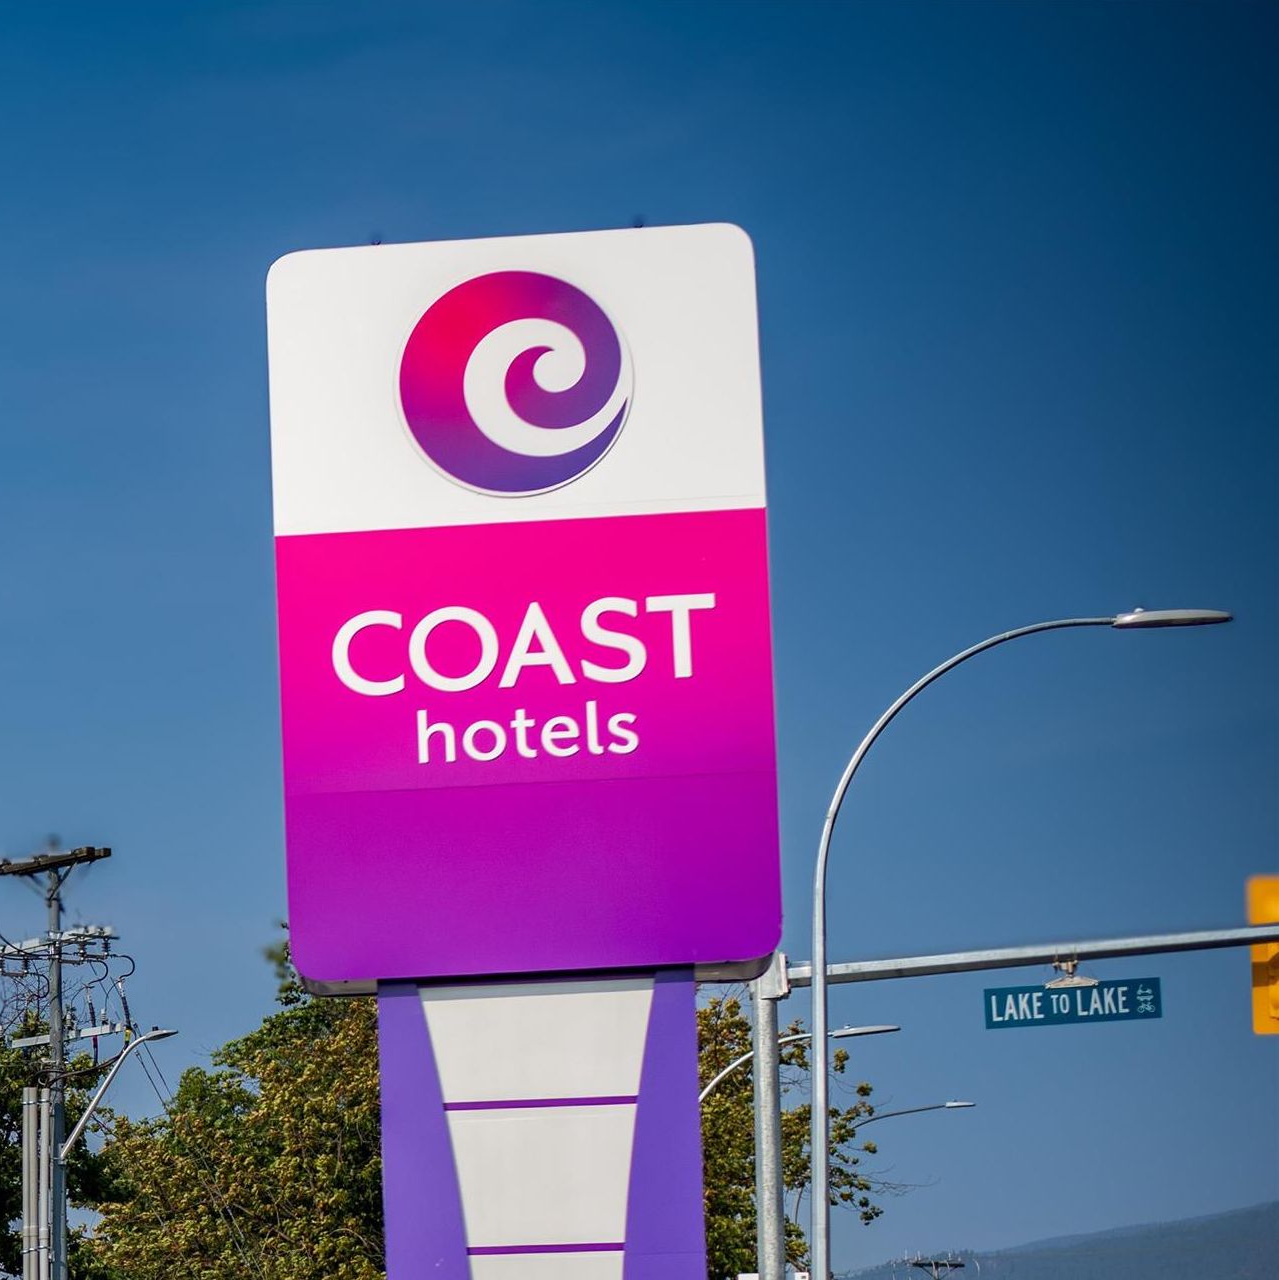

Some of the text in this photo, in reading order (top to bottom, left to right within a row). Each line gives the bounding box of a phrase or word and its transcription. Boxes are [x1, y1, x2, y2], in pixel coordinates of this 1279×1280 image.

[332, 593, 716, 697] COAST
[416, 700, 640, 764] hotels
[991, 986, 1130, 1022] LAKE TO LAKE
